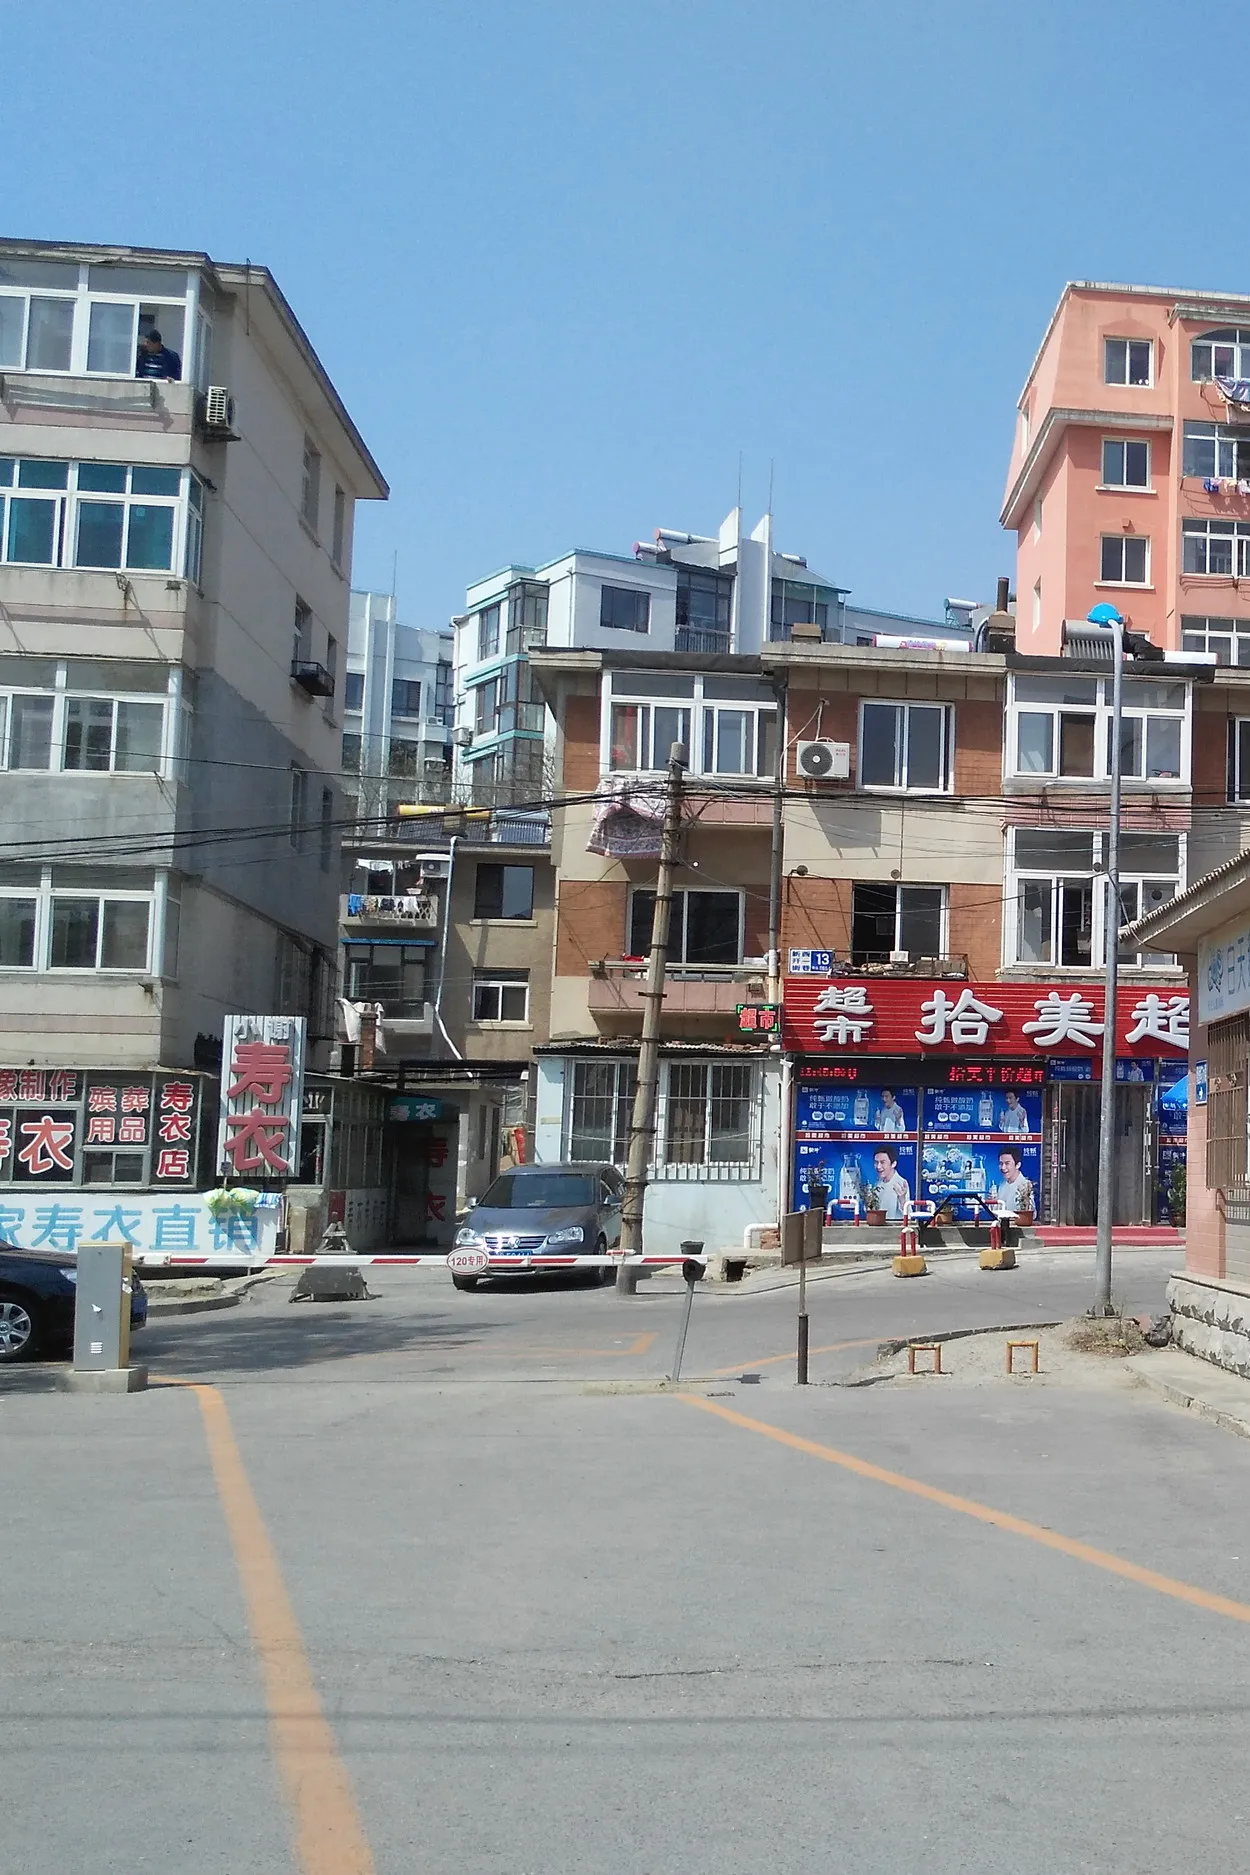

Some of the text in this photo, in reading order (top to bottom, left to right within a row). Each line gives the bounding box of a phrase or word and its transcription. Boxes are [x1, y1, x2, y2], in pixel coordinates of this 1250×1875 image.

[816, 953, 830, 965] 13
[739, 1007, 776, 1030] 超市
[813, 986, 874, 1045] 超市
[89, 1086, 149, 1112] 殡葬
[223, 1041, 293, 1172] 寿衣
[88, 1117, 145, 1143] 用品
[157, 1081, 194, 1179] 寿衣店
[0, 1115, 74, 1174] 衣
[451, 1255, 484, 1266] 120专用
